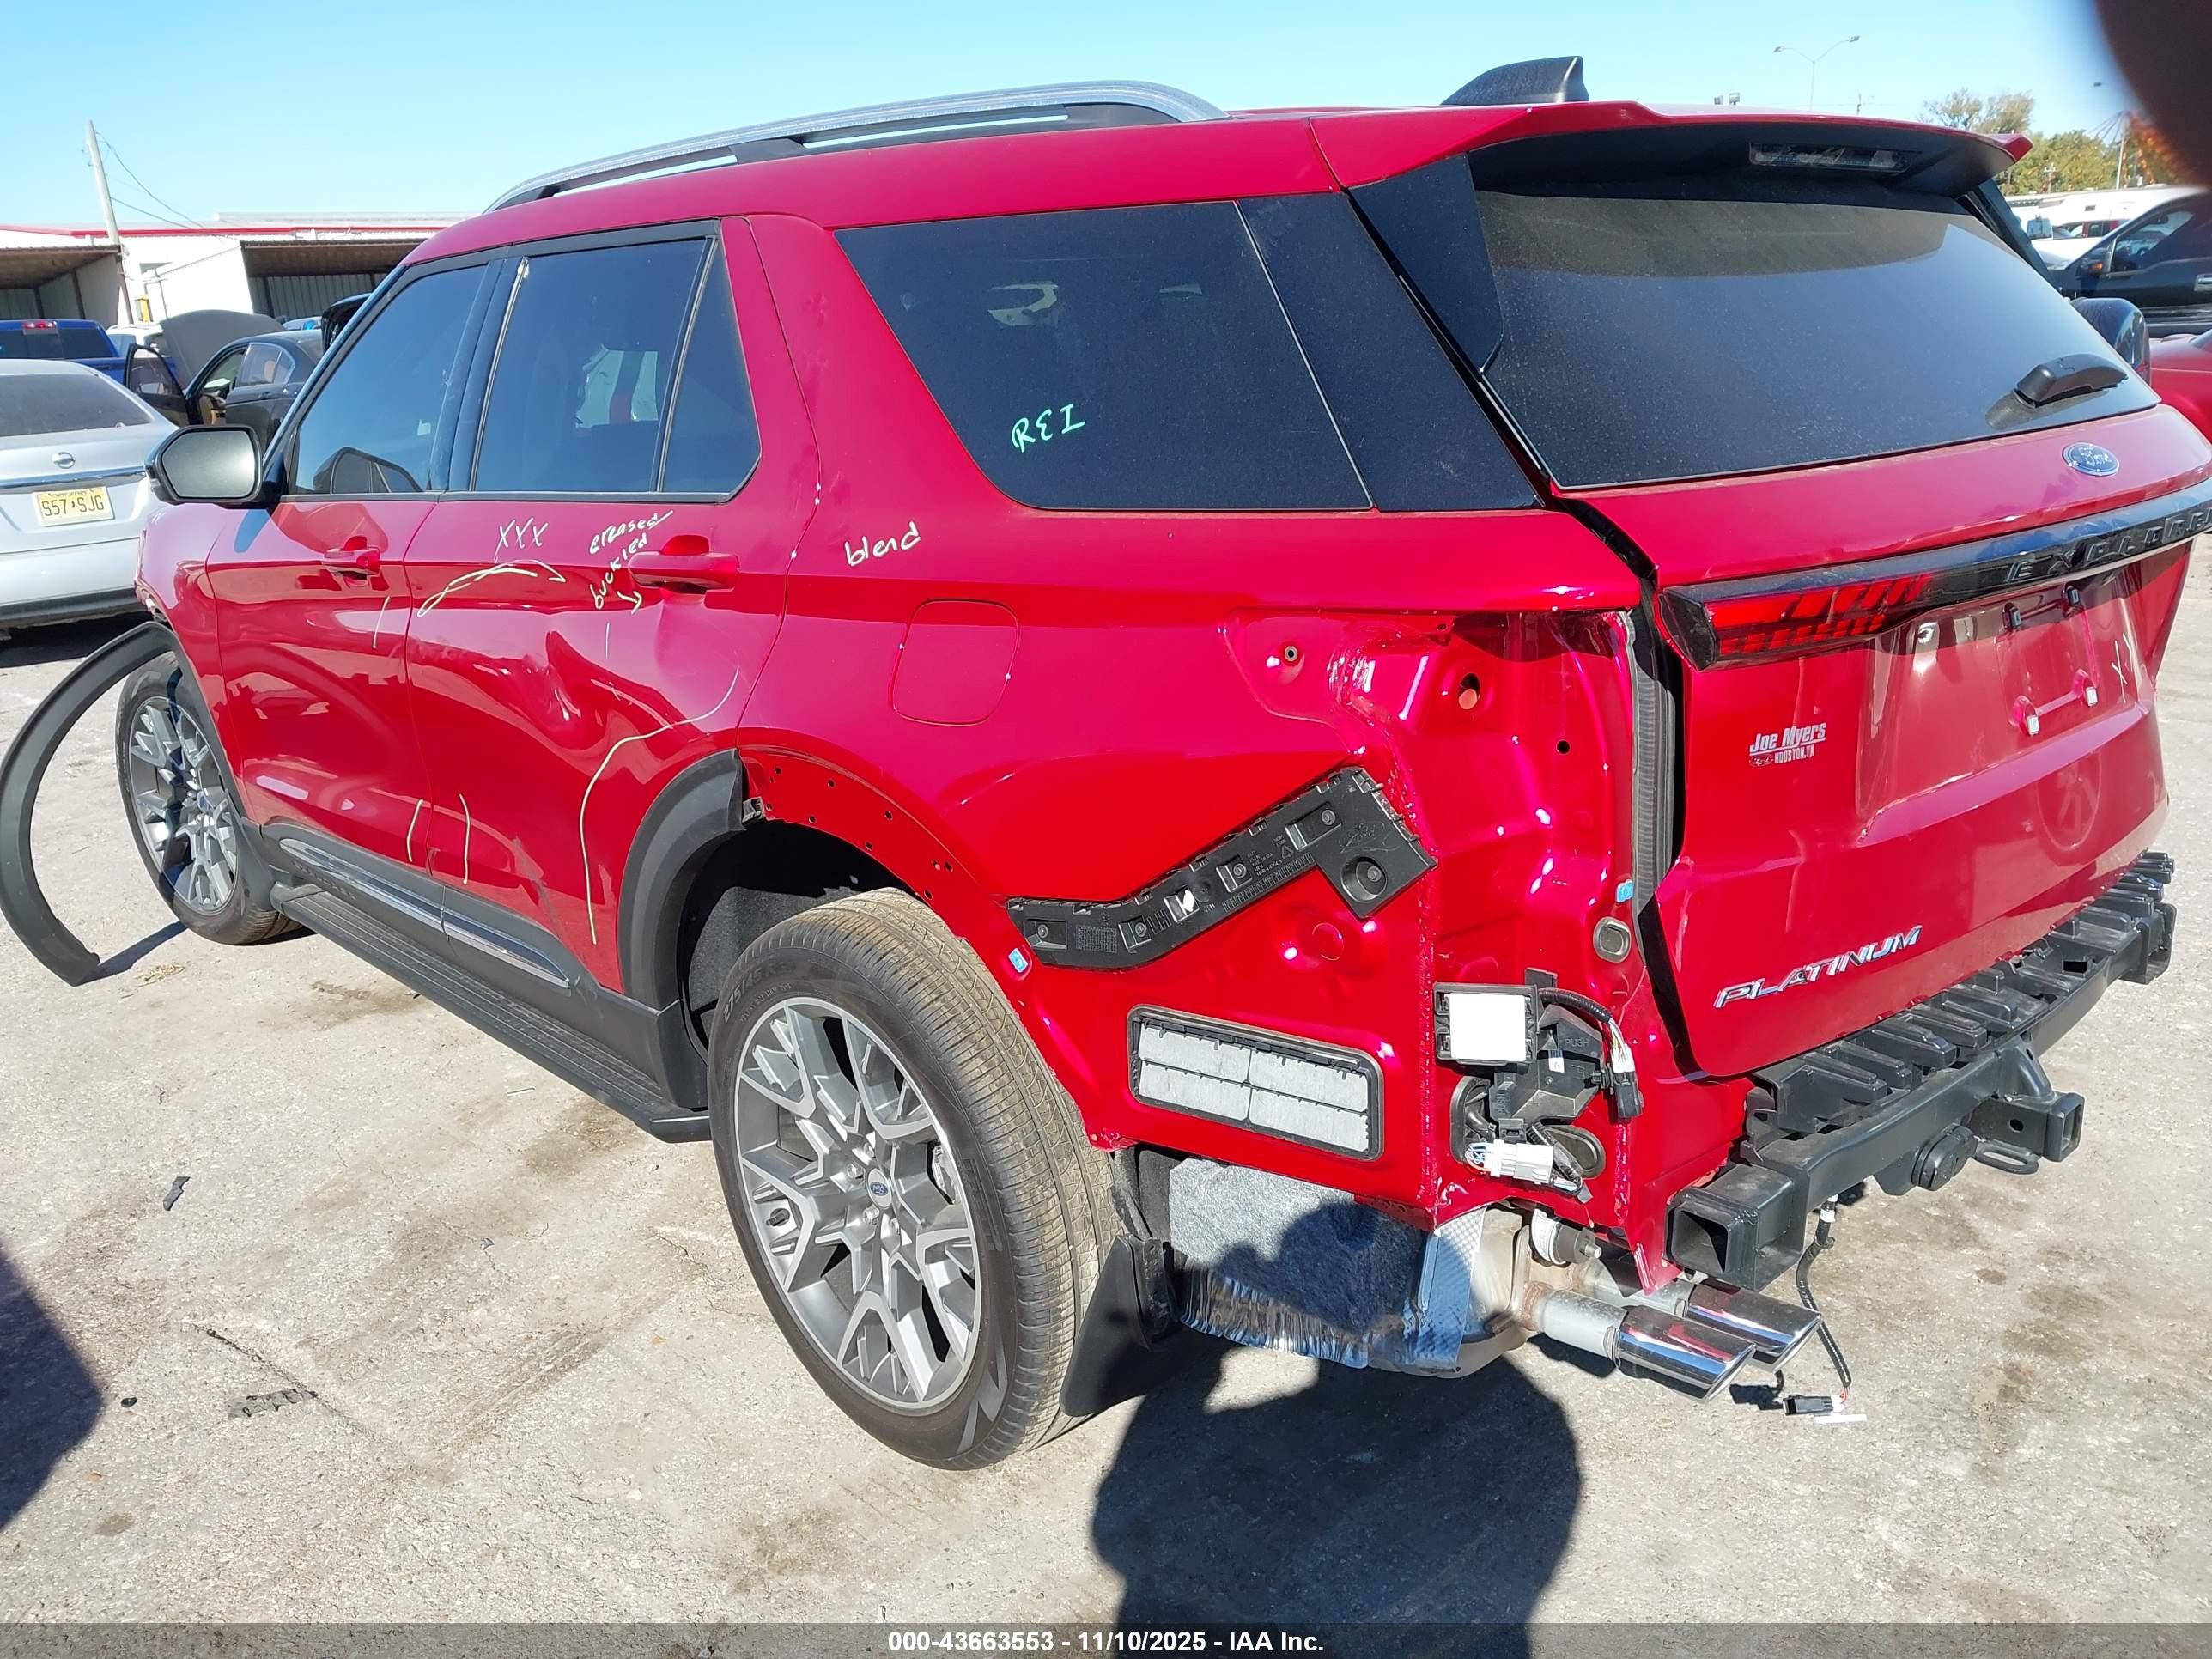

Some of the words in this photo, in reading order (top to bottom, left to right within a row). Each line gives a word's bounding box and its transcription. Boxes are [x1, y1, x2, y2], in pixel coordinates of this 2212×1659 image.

[1011, 403, 1085, 453] REI
[844, 521, 921, 566] blend
[1749, 733, 1778, 753] Joe
[1782, 722, 1827, 748] Myers
[1713, 925, 1923, 1008] PLATINUM
[1565, 1038, 1589, 1047] PUSH
